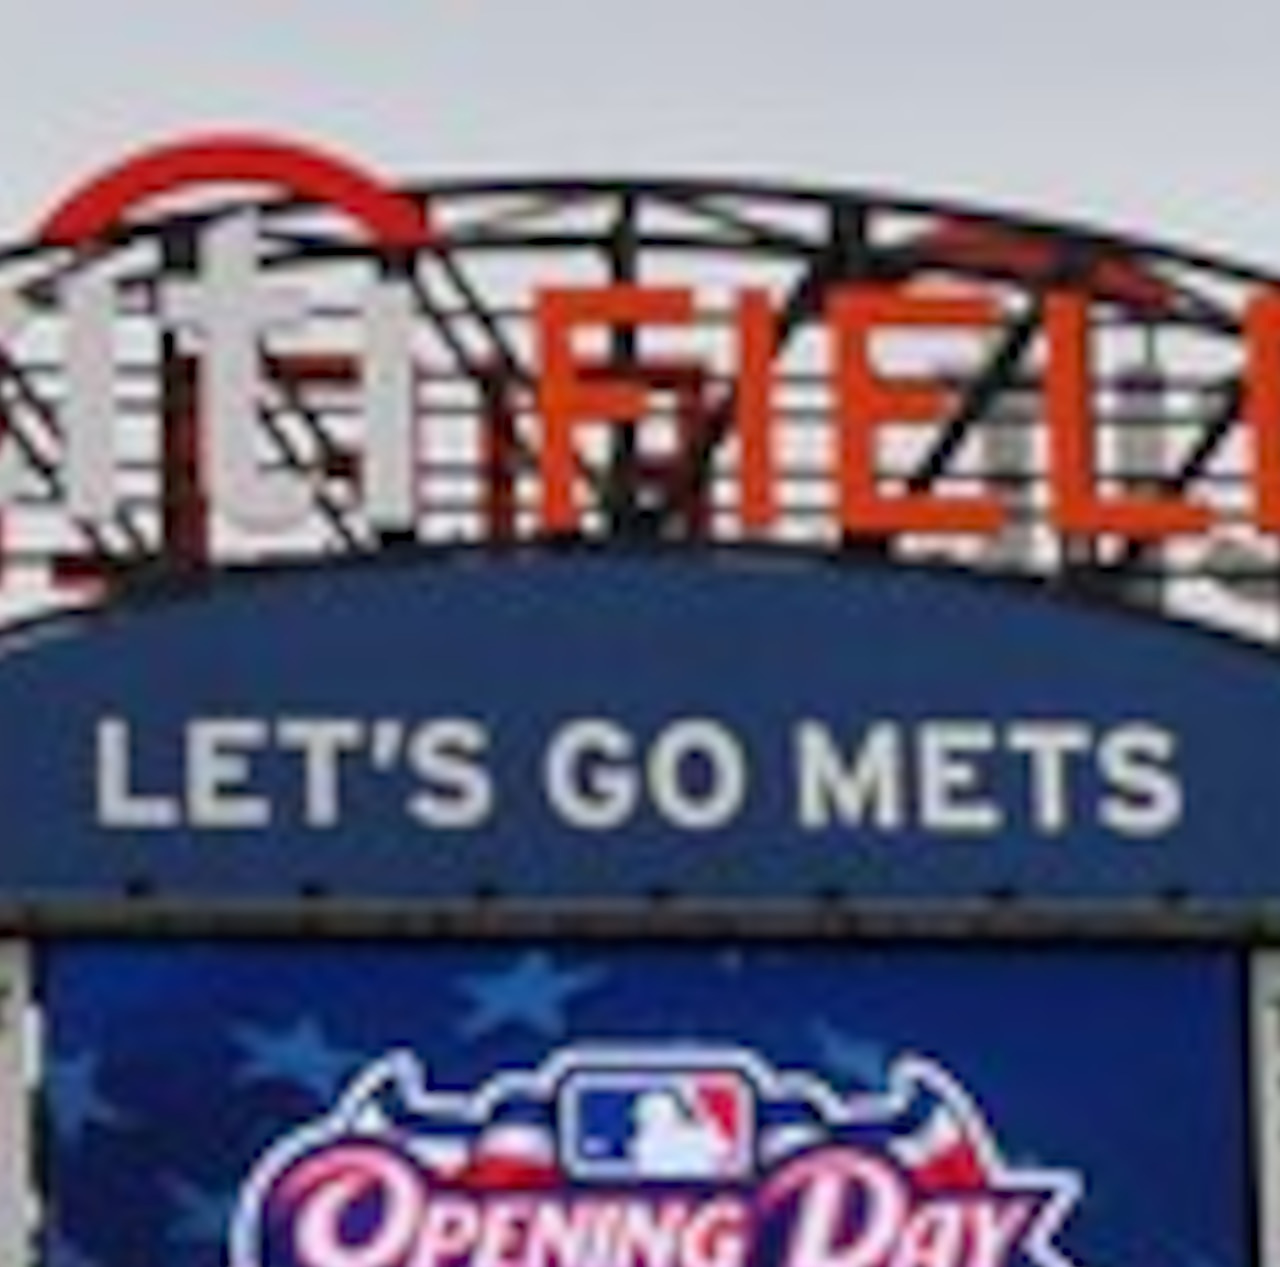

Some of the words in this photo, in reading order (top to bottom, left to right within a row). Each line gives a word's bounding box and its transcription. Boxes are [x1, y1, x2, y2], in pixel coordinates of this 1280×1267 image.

[94, 718, 494, 830] LET'S
[544, 718, 747, 830] GO
[798, 720, 1185, 834] METS
